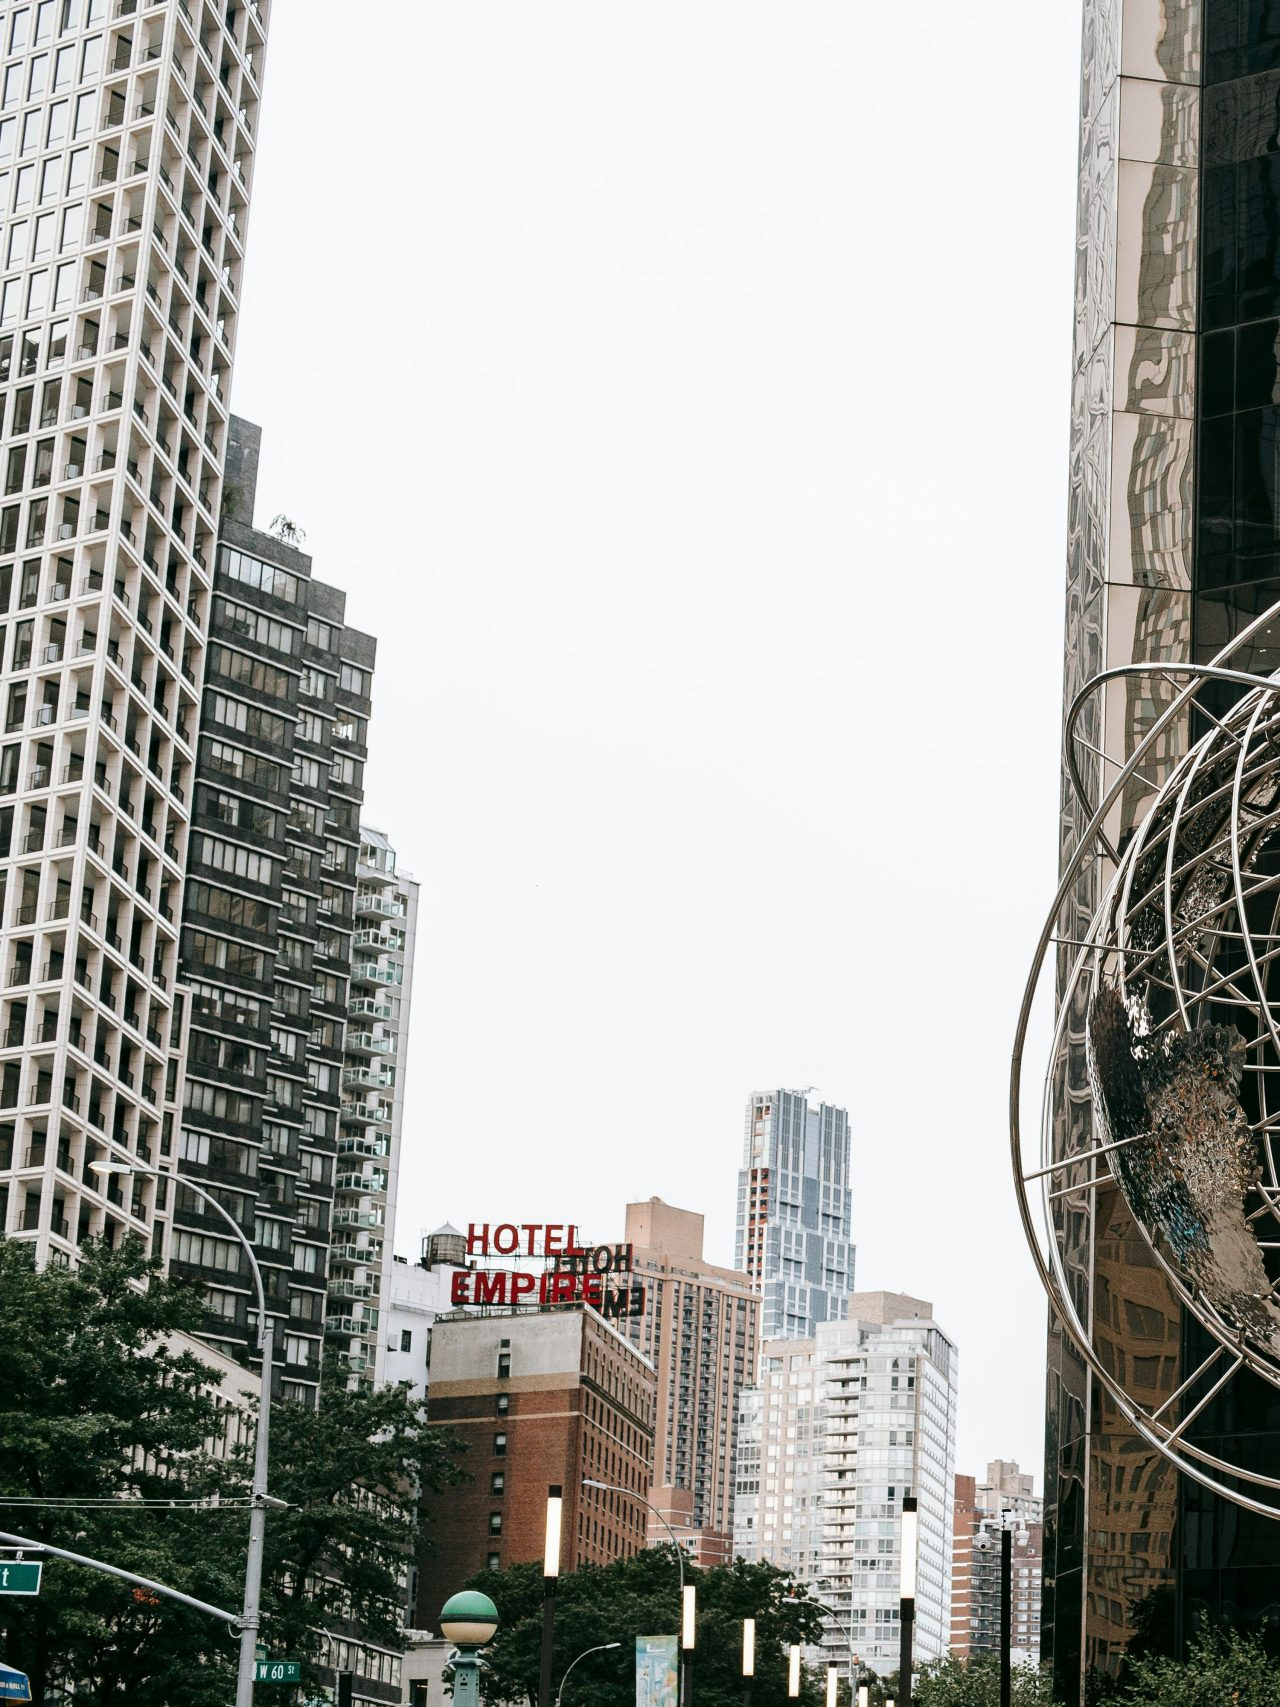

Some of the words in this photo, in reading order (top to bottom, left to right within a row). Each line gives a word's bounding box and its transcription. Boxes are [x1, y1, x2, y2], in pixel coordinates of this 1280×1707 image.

[467, 1223, 585, 1256] HOTEL
[451, 1271, 603, 1304] EMPIRE
[259, 1664, 268, 1679] W
[271, 1664, 284, 1680] 60
[288, 1665, 295, 1674] St
